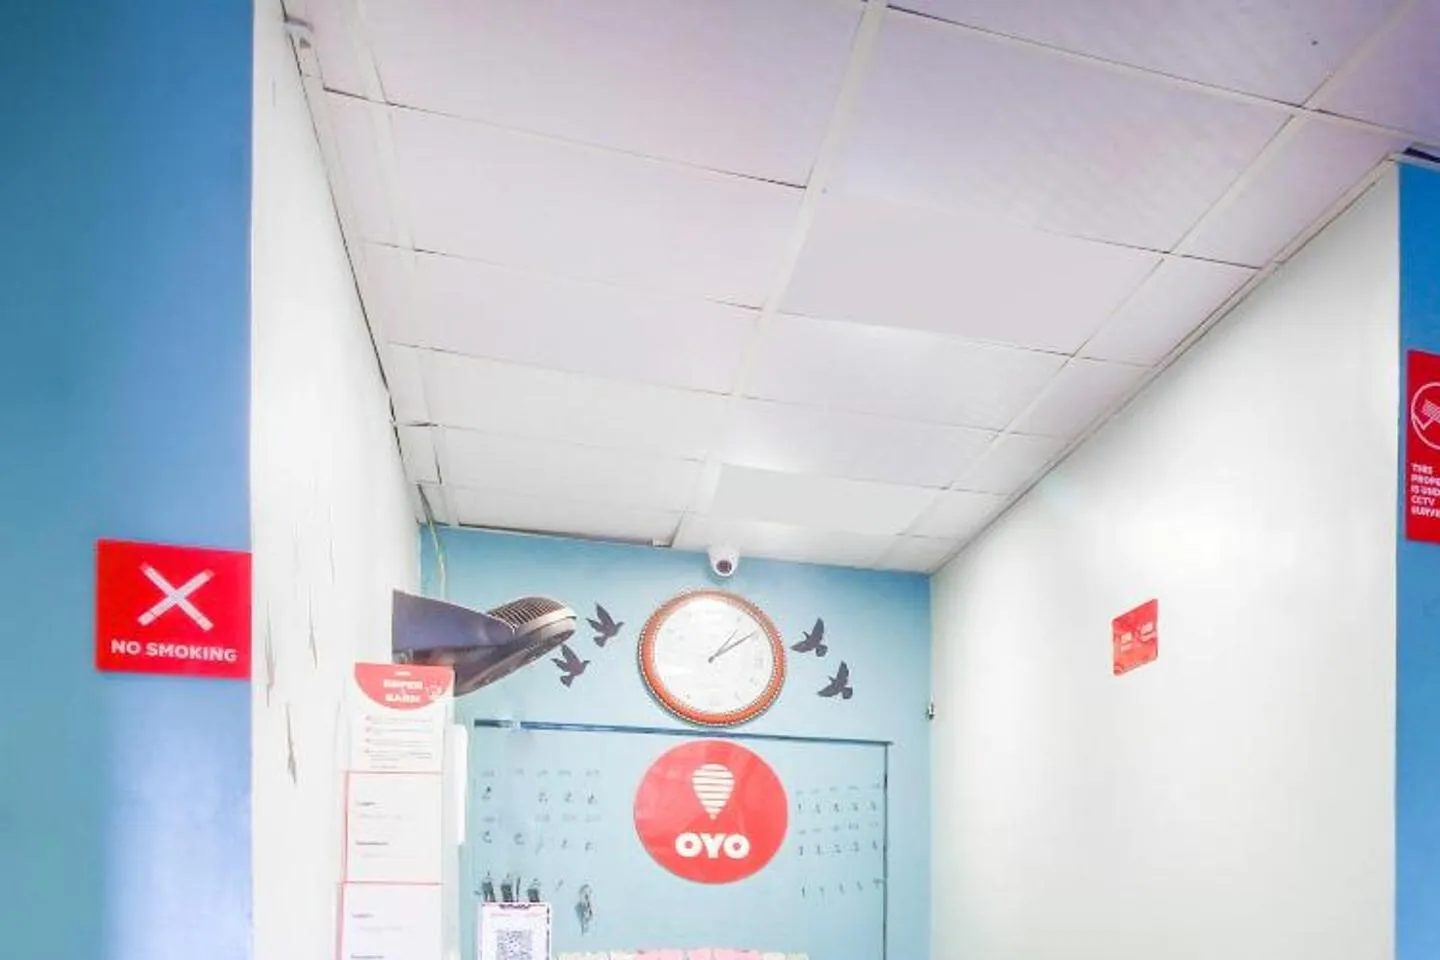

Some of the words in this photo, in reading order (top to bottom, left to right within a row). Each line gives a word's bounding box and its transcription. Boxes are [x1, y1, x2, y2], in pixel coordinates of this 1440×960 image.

[1411, 463, 1433, 475] THIS
[1410, 484, 1420, 494] IS
[1410, 494, 1435, 506] CCTV
[111, 638, 141, 655] NO
[145, 642, 238, 663] SMOKING
[675, 831, 751, 859] OYO
